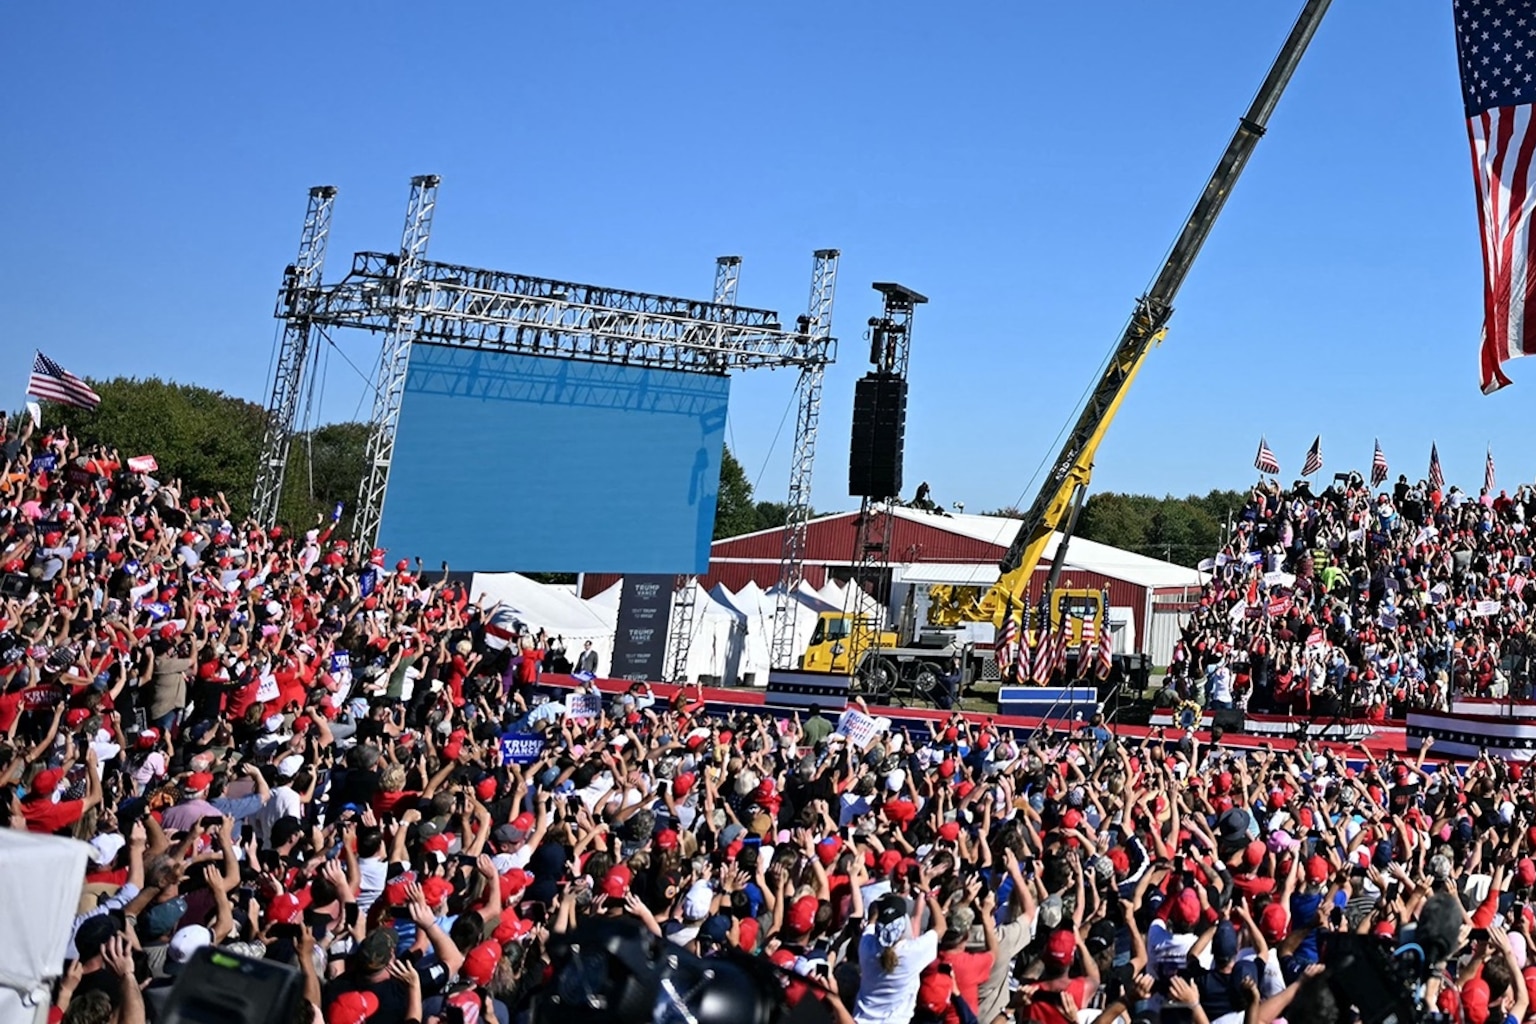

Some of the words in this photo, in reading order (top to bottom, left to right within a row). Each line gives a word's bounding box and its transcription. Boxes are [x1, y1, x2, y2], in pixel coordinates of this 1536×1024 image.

[25, 690, 62, 701] TRUMP
[849, 712, 875, 729] FIGHT!
[846, 719, 871, 735] FIGHT!
[504, 740, 544, 749] TRUMP
[507, 748, 539, 756] VANCE
